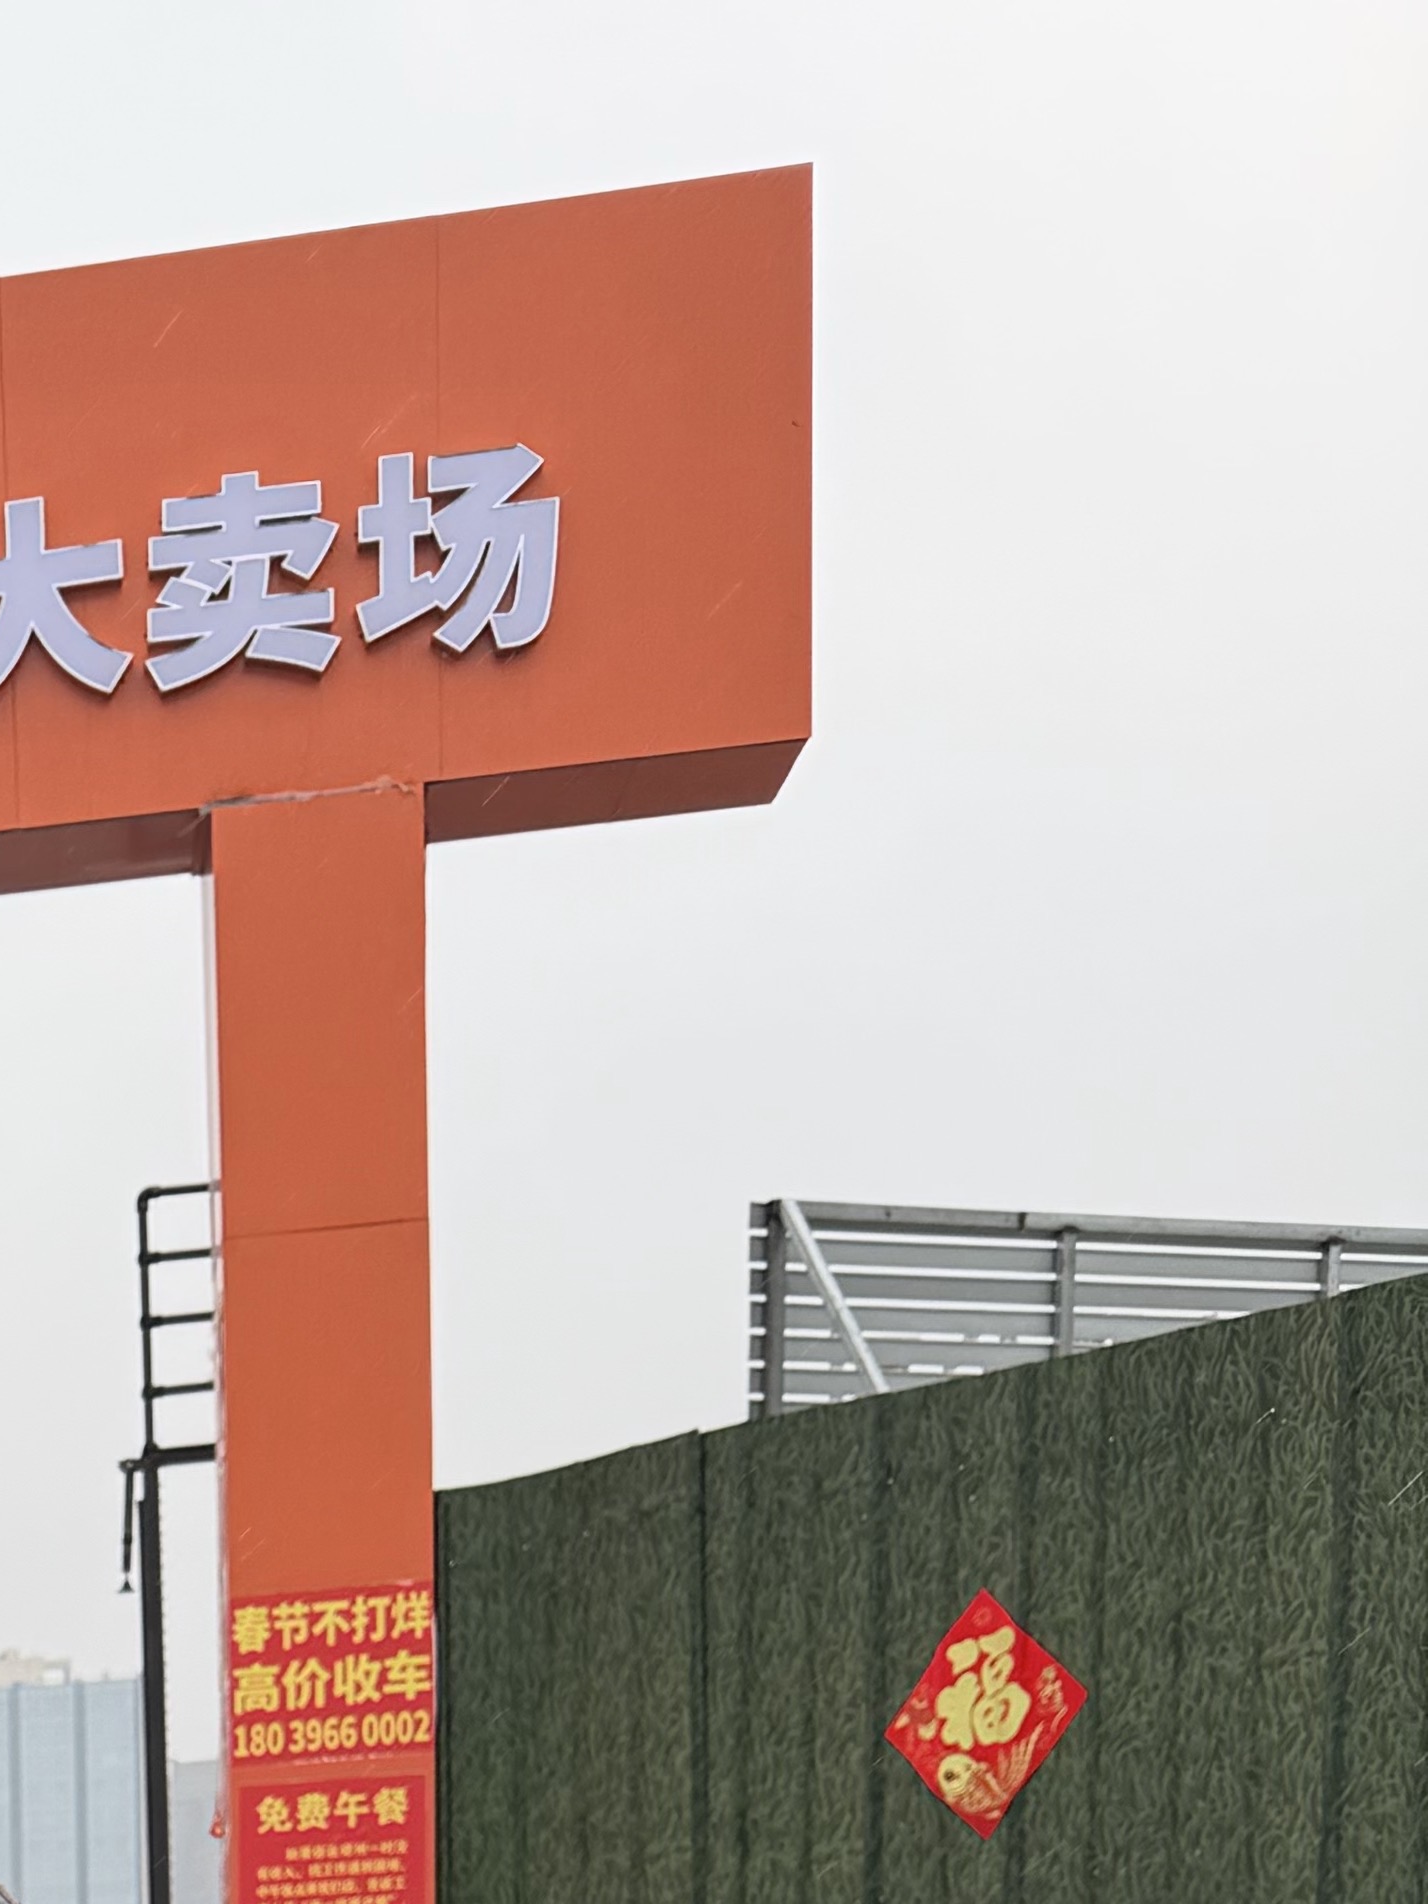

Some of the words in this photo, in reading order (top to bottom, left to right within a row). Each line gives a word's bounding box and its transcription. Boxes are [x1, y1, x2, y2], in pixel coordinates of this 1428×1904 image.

[232, 1590, 432, 1655] 春节不打烊
[232, 1649, 433, 1716] 高价收车
[935, 1625, 1032, 1751] 福
[233, 1722, 285, 1758] 180
[288, 1715, 357, 1754] 3966
[361, 1709, 431, 1748] 0002
[255, 1786, 409, 1834] 免费午餐
